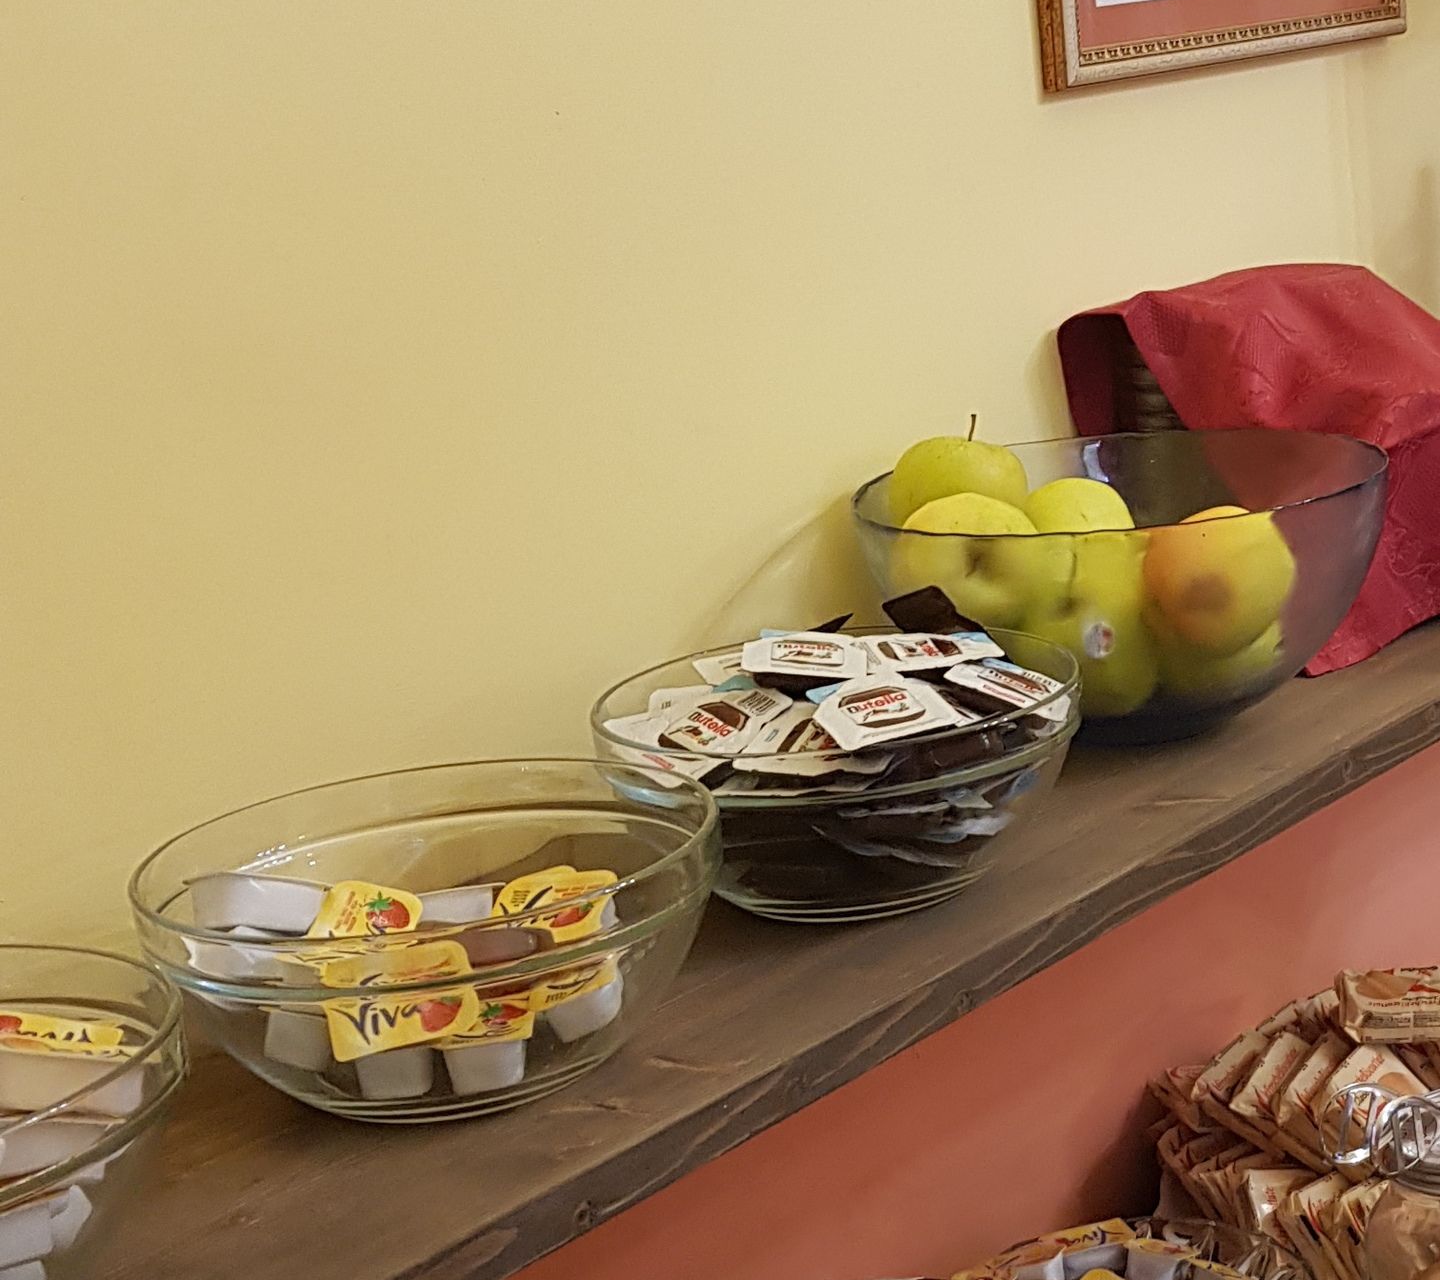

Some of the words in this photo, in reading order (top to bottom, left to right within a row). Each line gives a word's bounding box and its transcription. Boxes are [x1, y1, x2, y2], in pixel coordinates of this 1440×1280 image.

[847, 692, 908, 714] nutella
[688, 711, 732, 737] nutella
[329, 1000, 422, 1046] Viva
